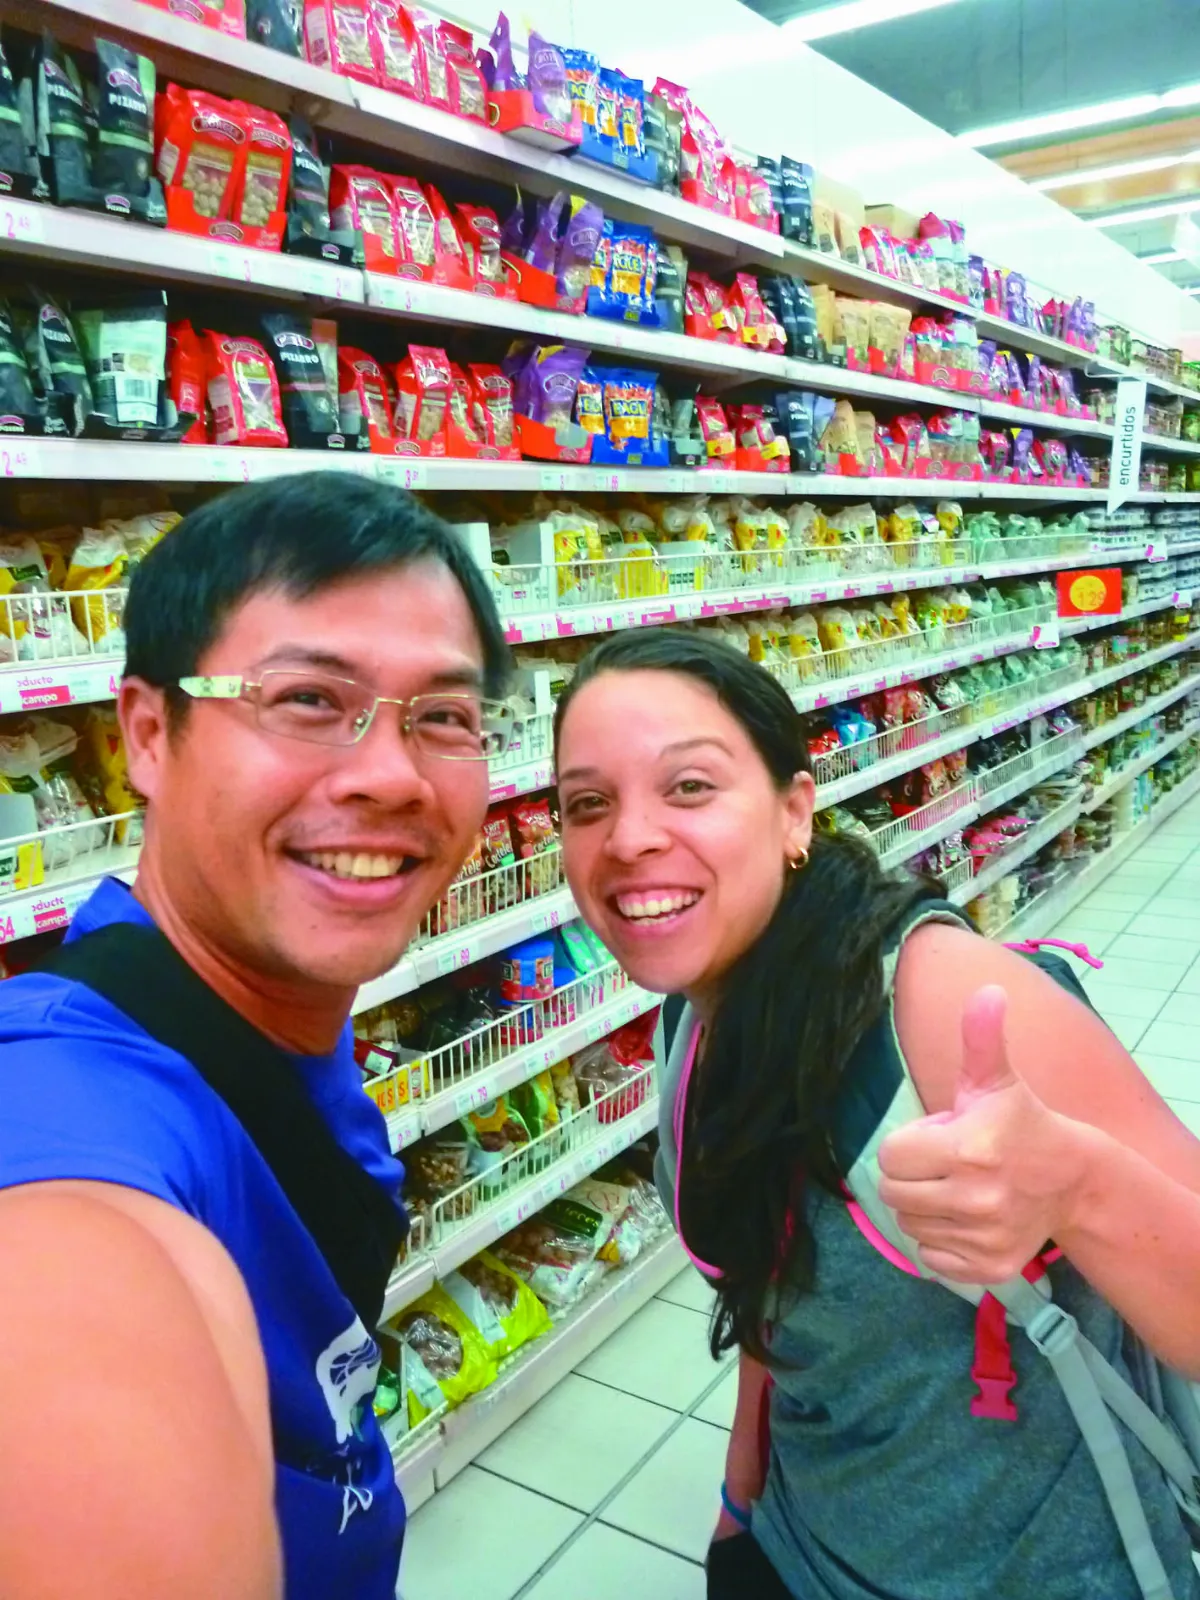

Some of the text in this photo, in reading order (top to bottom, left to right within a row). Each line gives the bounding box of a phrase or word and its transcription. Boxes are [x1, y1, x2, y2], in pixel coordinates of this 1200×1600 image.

[613, 401, 646, 416] EAGL
[1119, 406, 1136, 485] encurtidos
[22, 694, 58, 704] campo
